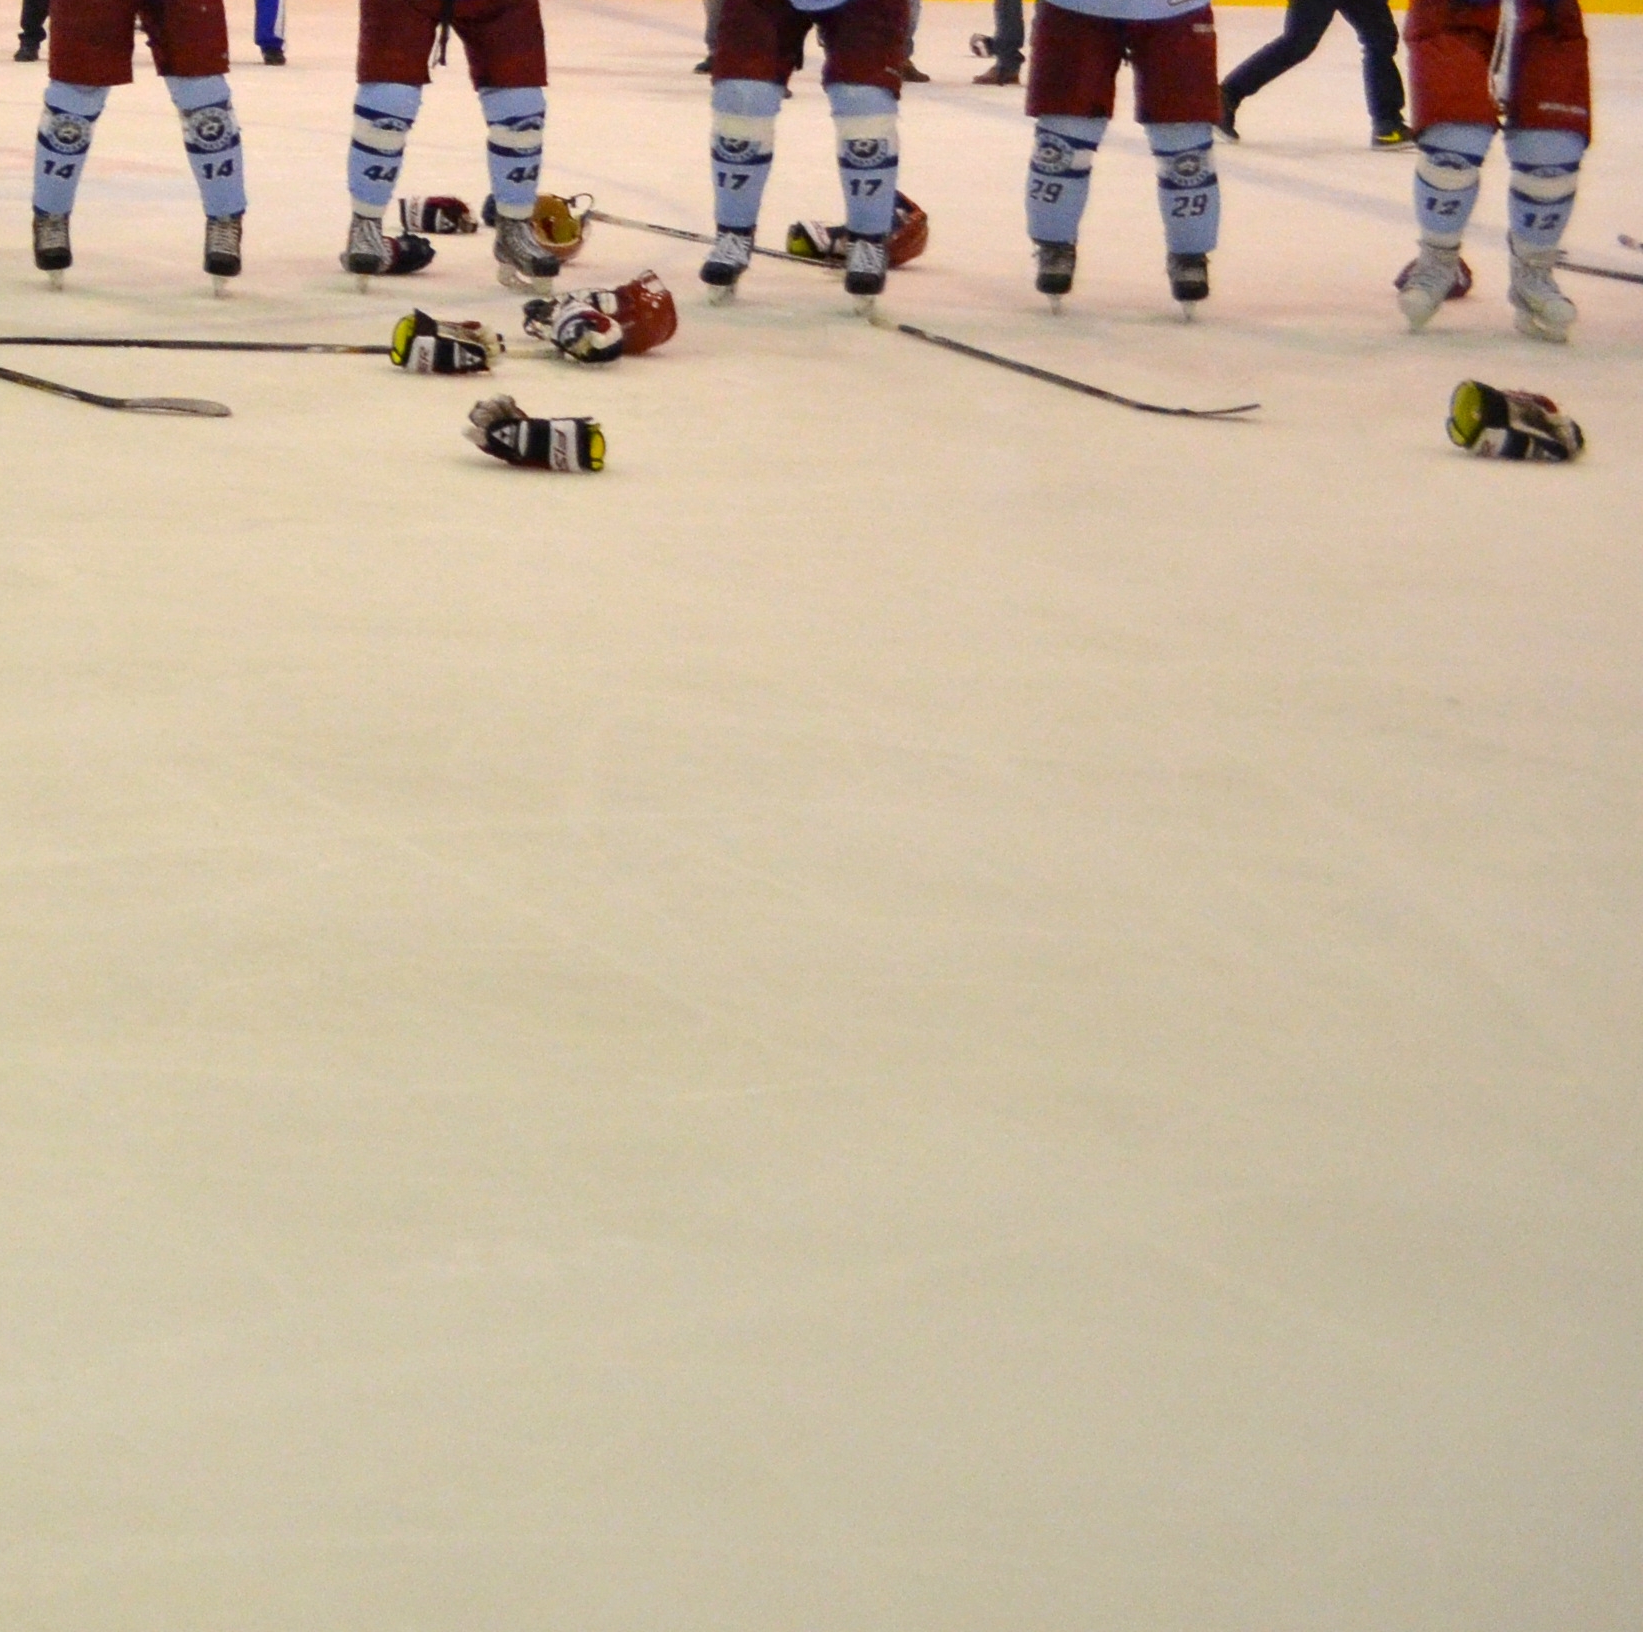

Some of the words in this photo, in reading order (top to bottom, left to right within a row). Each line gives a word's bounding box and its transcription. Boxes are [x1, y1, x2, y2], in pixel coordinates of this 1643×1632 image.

[42, 159, 76, 180] 14
[201, 158, 234, 180] 14
[362, 164, 399, 183] 44
[505, 164, 540, 184] 44
[717, 171, 750, 191] 17
[849, 178, 883, 197] 17
[1029, 178, 1064, 204] 29
[1171, 193, 1208, 218] 29
[1425, 196, 1461, 216] 12
[1523, 212, 1561, 230] 12
